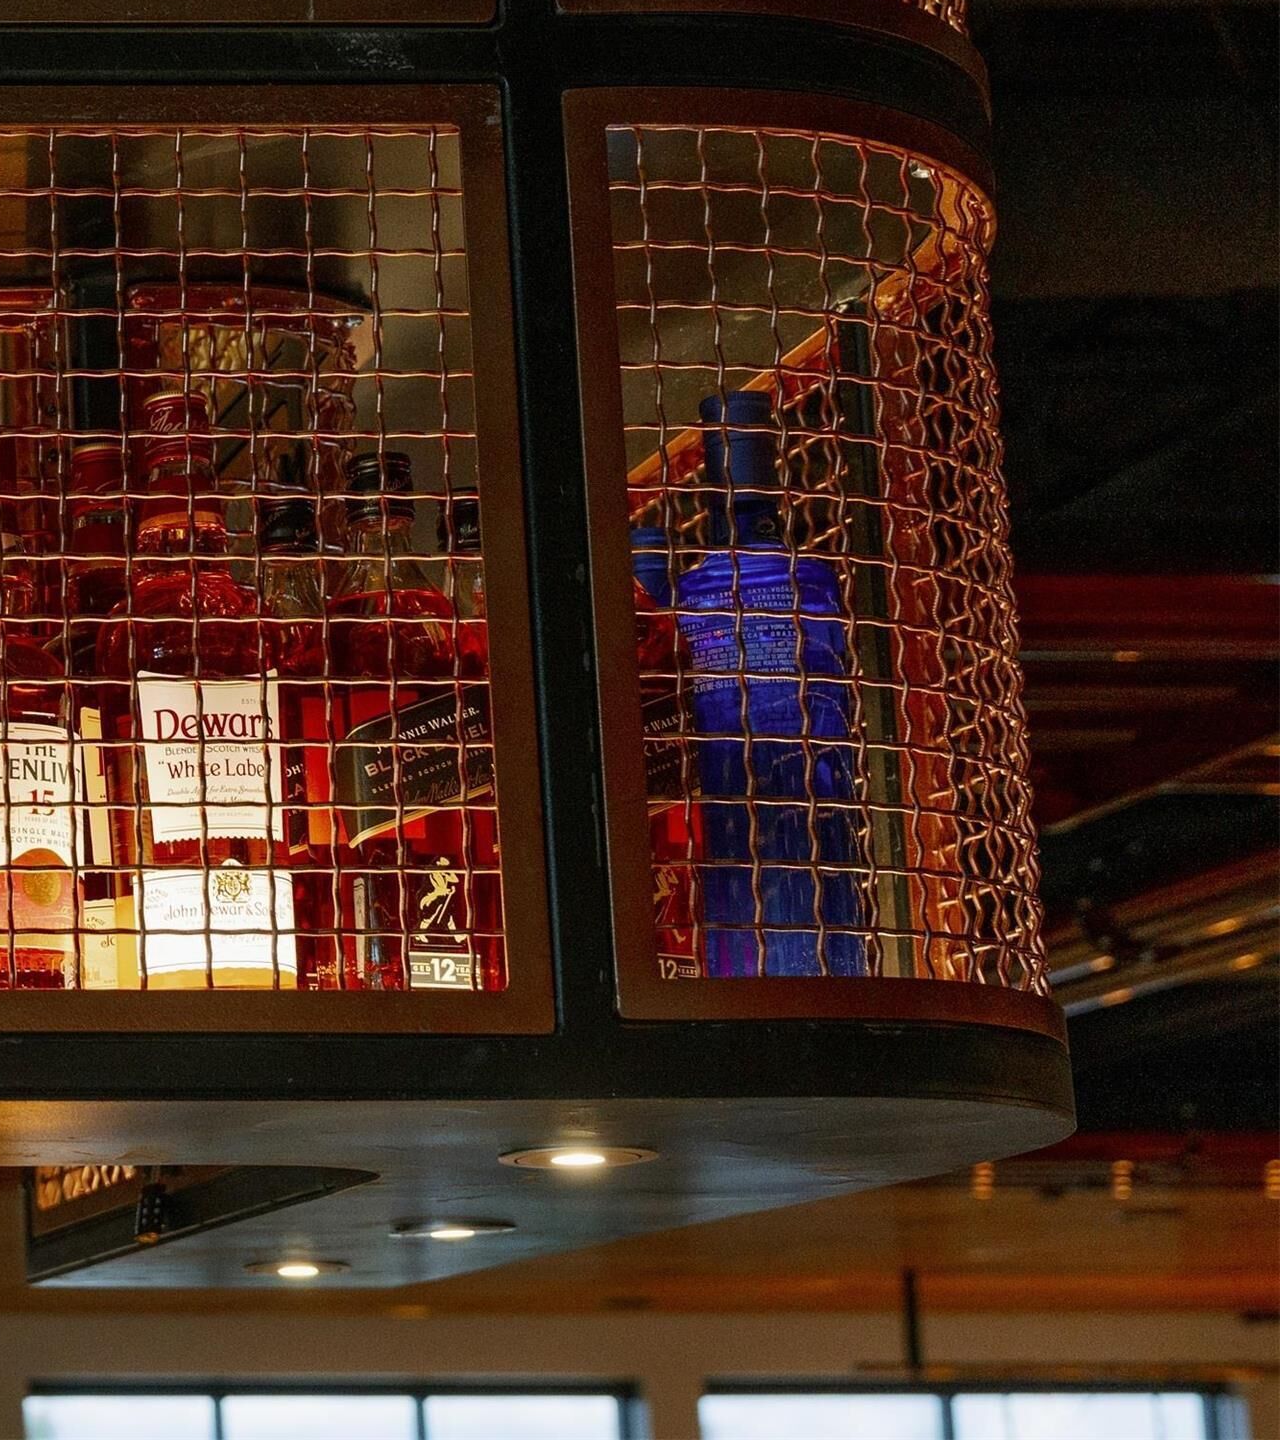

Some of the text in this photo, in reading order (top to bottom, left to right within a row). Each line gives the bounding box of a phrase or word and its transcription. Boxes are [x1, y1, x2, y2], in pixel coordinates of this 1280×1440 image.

[25, 743, 57, 759] THE
[165, 745, 241, 757] BLENDE SCOTCH
[225, 759, 266, 778] Labe
[364, 746, 430, 778] BLCK
[27, 789, 55, 816] 15
[11, 826, 46, 836] SINGLE
[163, 903, 254, 921] John &
[412, 957, 457, 982] GED 12
[657, 958, 679, 980] 12
